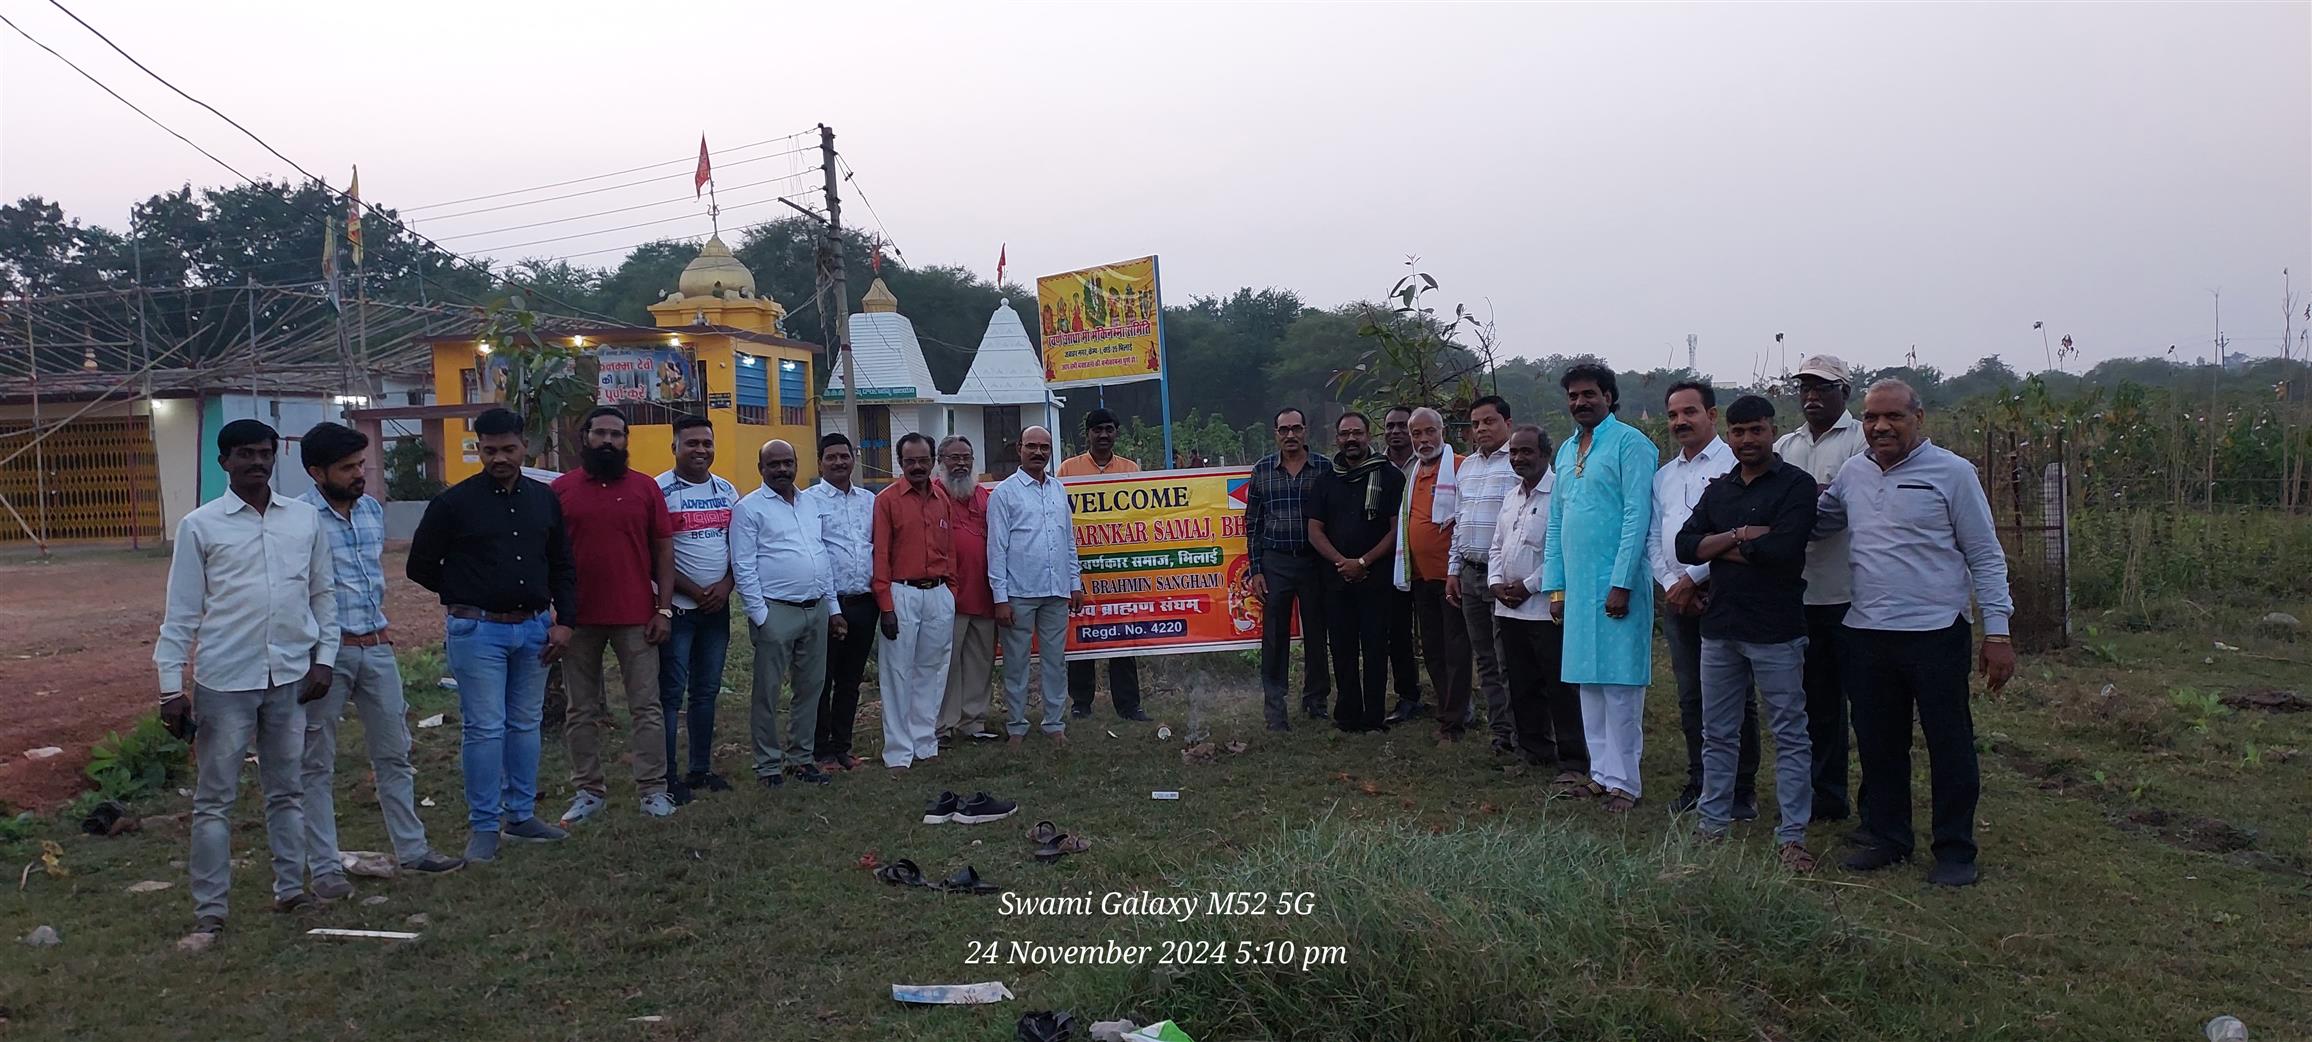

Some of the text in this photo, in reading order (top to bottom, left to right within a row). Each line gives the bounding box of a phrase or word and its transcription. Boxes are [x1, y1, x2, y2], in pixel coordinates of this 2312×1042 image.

[682, 498, 728, 509] ADVENTURE
[1073, 521, 1149, 546] ARNKAR
[1154, 516, 1216, 543] SAMAJ,
[1132, 554, 1174, 568] समाज,
[1178, 547, 1218, 566] भिलाई
[1092, 577, 1151, 595] BRAHMIN
[1156, 572, 1224, 591] SANGHAM)
[1101, 600, 1154, 616] ब्राह्मण
[1160, 597, 1202, 614] संघम्
[1082, 622, 1182, 640] Regd. No. 4220
